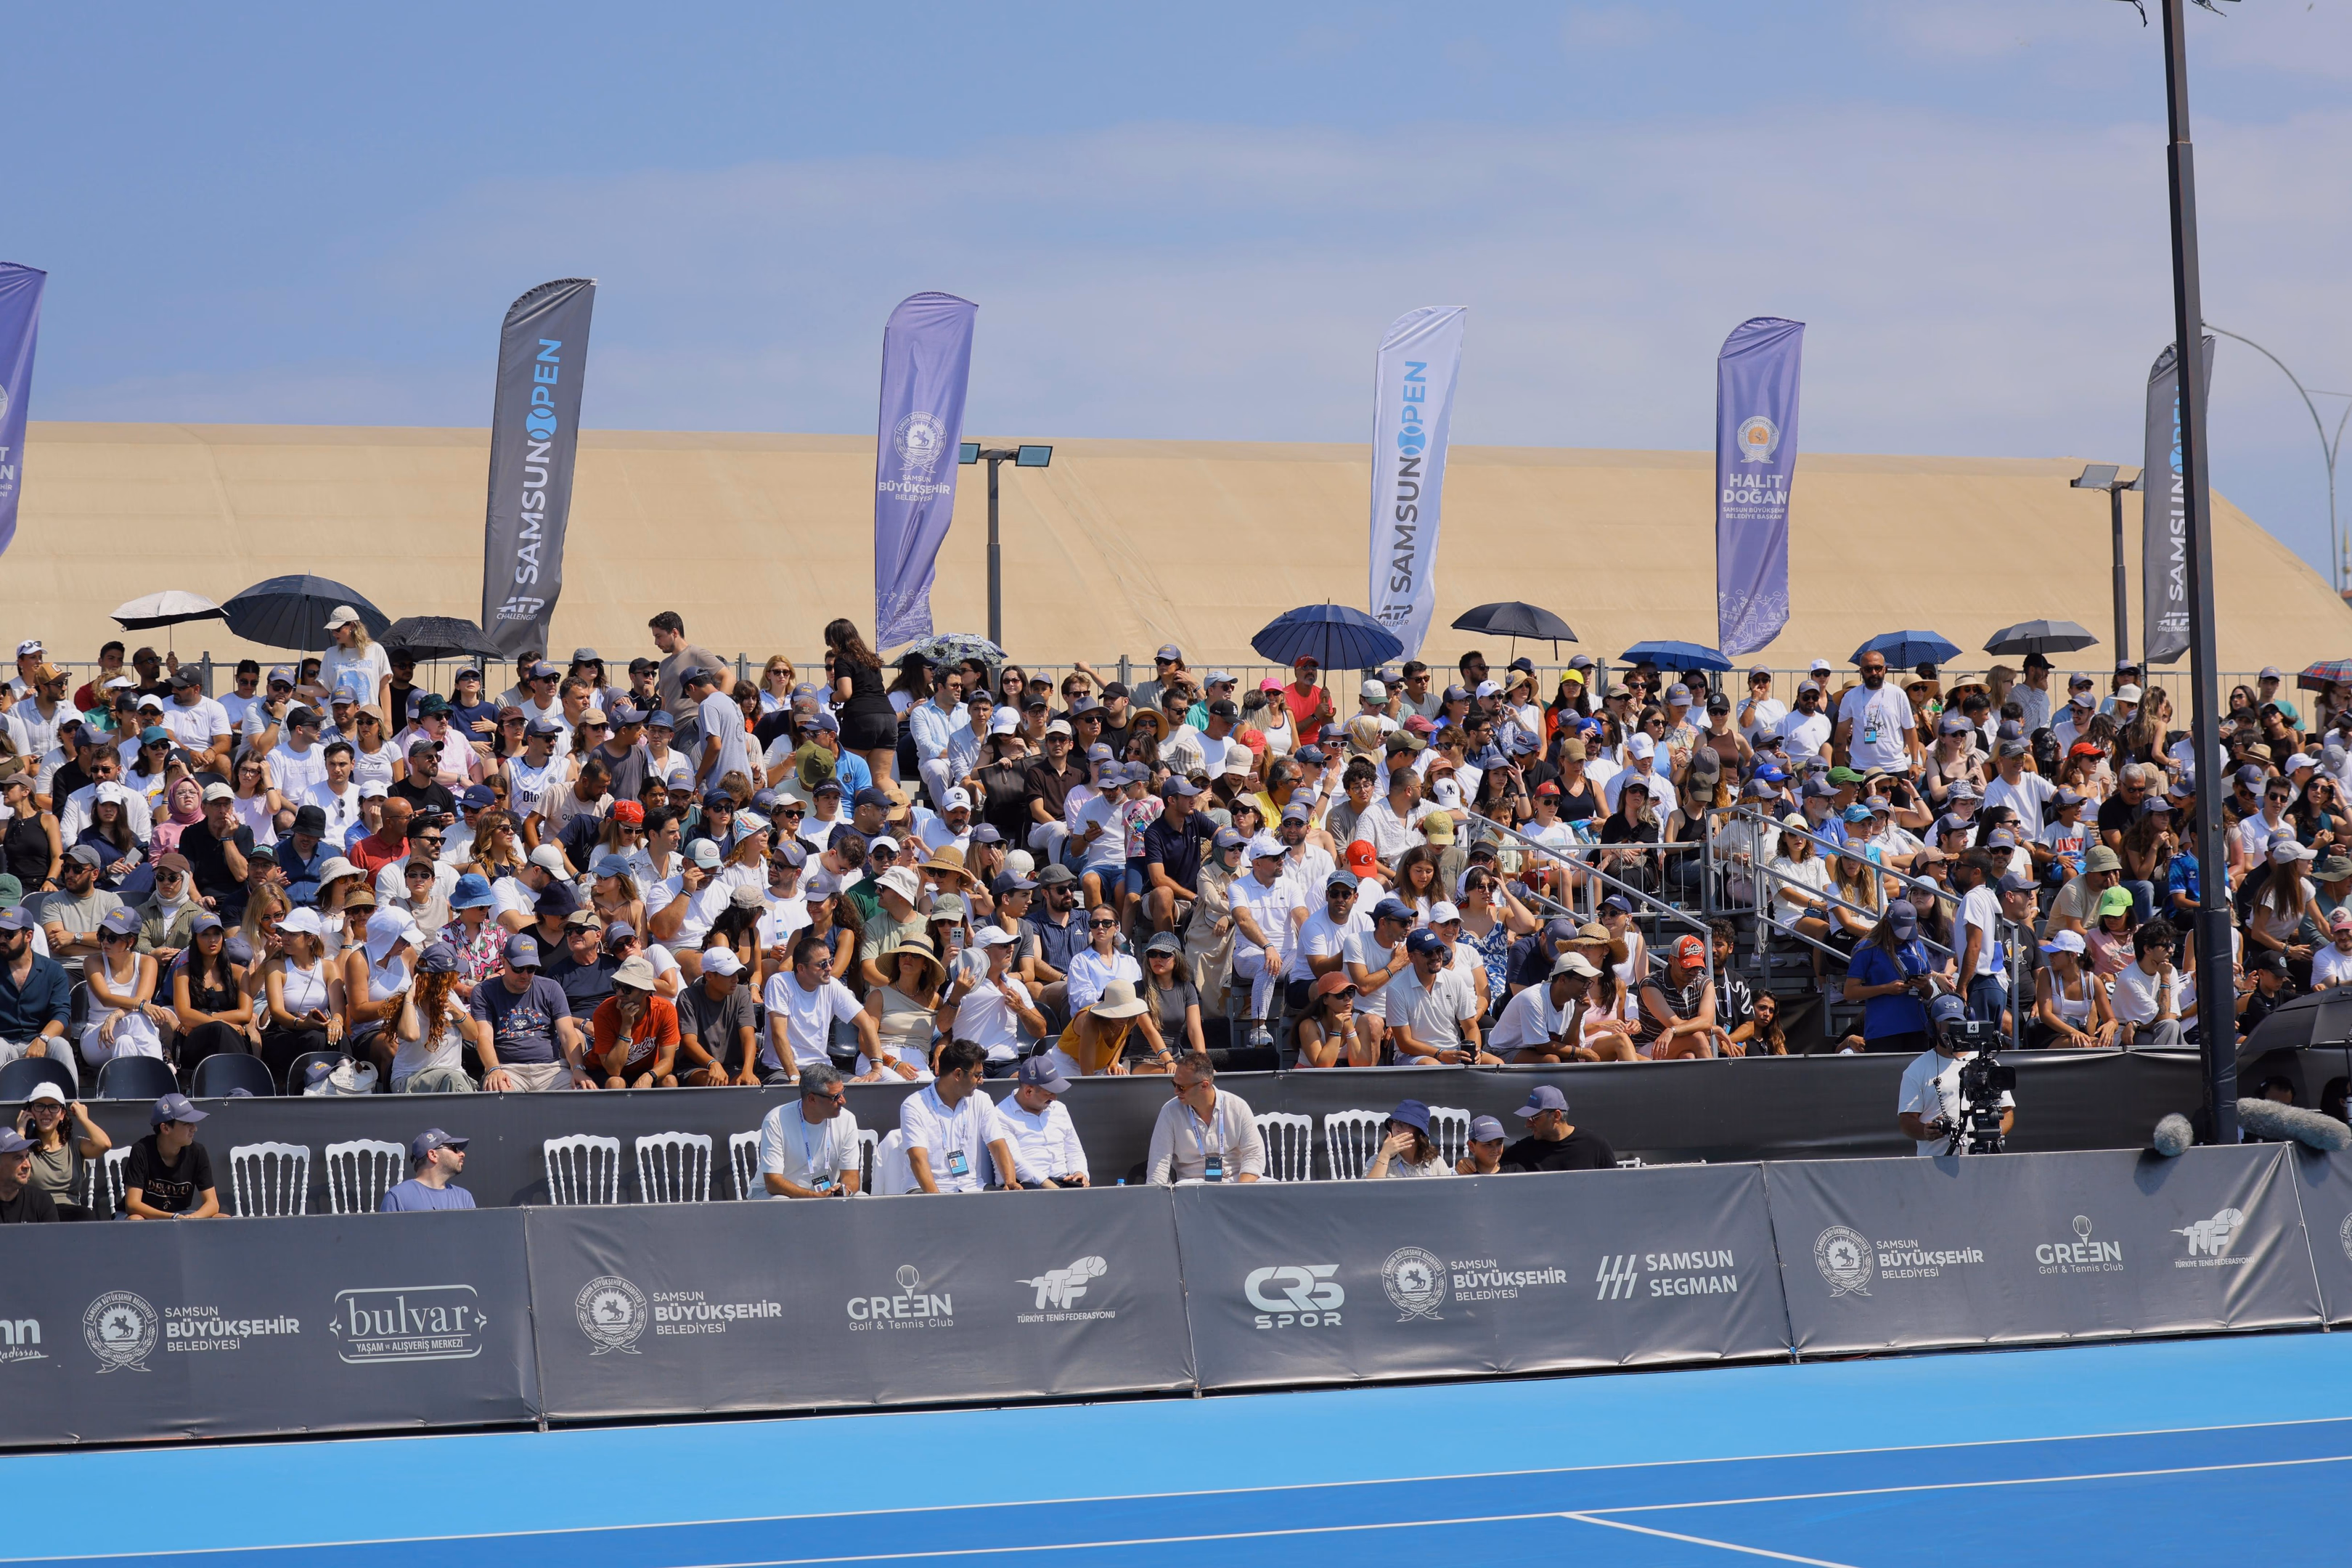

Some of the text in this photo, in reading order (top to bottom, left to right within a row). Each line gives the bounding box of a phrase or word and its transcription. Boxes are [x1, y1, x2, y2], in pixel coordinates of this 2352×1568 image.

[878, 481, 950, 495] BÜYÜKŞEHİR
[1723, 489, 1787, 504] DOĞAN
[515, 439, 551, 584] SAMSUN
[1390, 456, 1421, 593] SAMSUN
[497, 597, 544, 613] ATP
[2056, 837, 2083, 853] JUST
[629, 1037, 656, 1054] evi's
[1877, 1239, 1918, 1249] SAMSUN
[1646, 1250, 1734, 1271] SAMSUN
[1879, 1247, 1984, 1267] BÜYÜKŞEHİR
[2035, 1241, 2122, 1264] GREEN
[1451, 1259, 1496, 1270] SAMSUN
[2038, 1265, 2058, 1275] Golf
[2070, 1264, 2100, 1273] Tennis
[2103, 1262, 2124, 1272] Club
[2175, 1256, 2255, 1268] TÜRKİYE TENİS FEDERASYONU
[1453, 1267, 1567, 1289] BÜYÜKŞEHİR
[1882, 1267, 1939, 1279] BELEDİYESİ
[1244, 1264, 1344, 1312] CRS
[1649, 1275, 1738, 1297] SEGMAN
[653, 1291, 704, 1302] SAMSUN
[1455, 1287, 1518, 1302] BELEDİYESİ
[165, 1307, 219, 1318] SAMSUN
[655, 1299, 782, 1322] BÜYÜKŞEHİR
[847, 1294, 953, 1320] GREEN
[346, 1295, 468, 1336] bulvar
[1017, 1310, 1116, 1323] TÜRKİYE TENİS FEDERASYONU
[1254, 1312, 1342, 1329] SPOR
[166, 1315, 300, 1338] BÜYÜKŞEHİR
[656, 1321, 726, 1335] BELEDİYESİ
[849, 1318, 954, 1331] Golf & Tennis Club
[167, 1338, 240, 1352] BELEDİYESİ
[356, 1342, 384, 1354] YAŞAM
[392, 1338, 430, 1353] ALIŞVERİŞ
[431, 1336, 463, 1349] MERKEZİ
